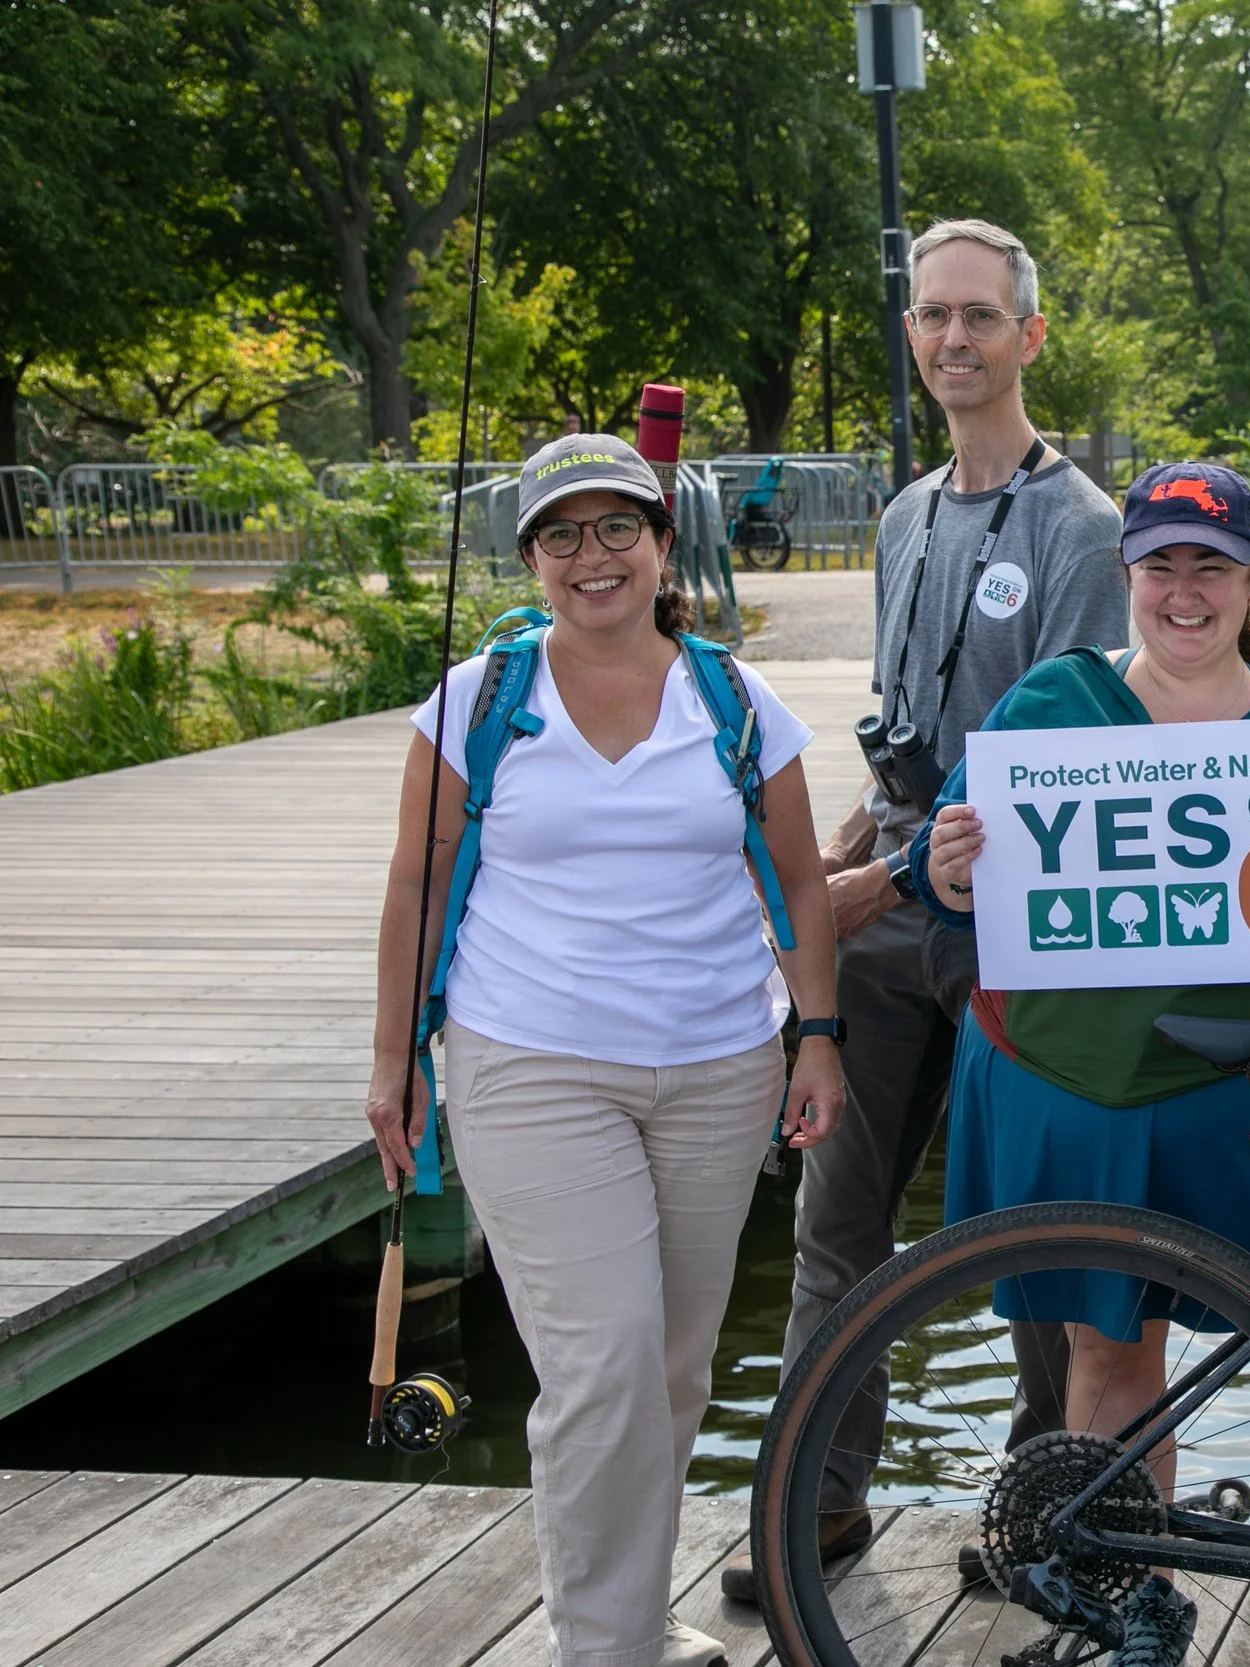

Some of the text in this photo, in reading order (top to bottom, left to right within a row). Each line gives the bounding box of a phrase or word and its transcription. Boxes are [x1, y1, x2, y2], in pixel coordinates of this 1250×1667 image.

[536, 453, 616, 480] trustees
[988, 578, 1022, 607] YES ON 6
[1009, 762, 1112, 789] Protect
[1115, 759, 1197, 784] Water
[1202, 758, 1222, 780] &
[1013, 792, 1231, 874] YES
[1142, 1236, 1194, 1257] SPECIALIZED
